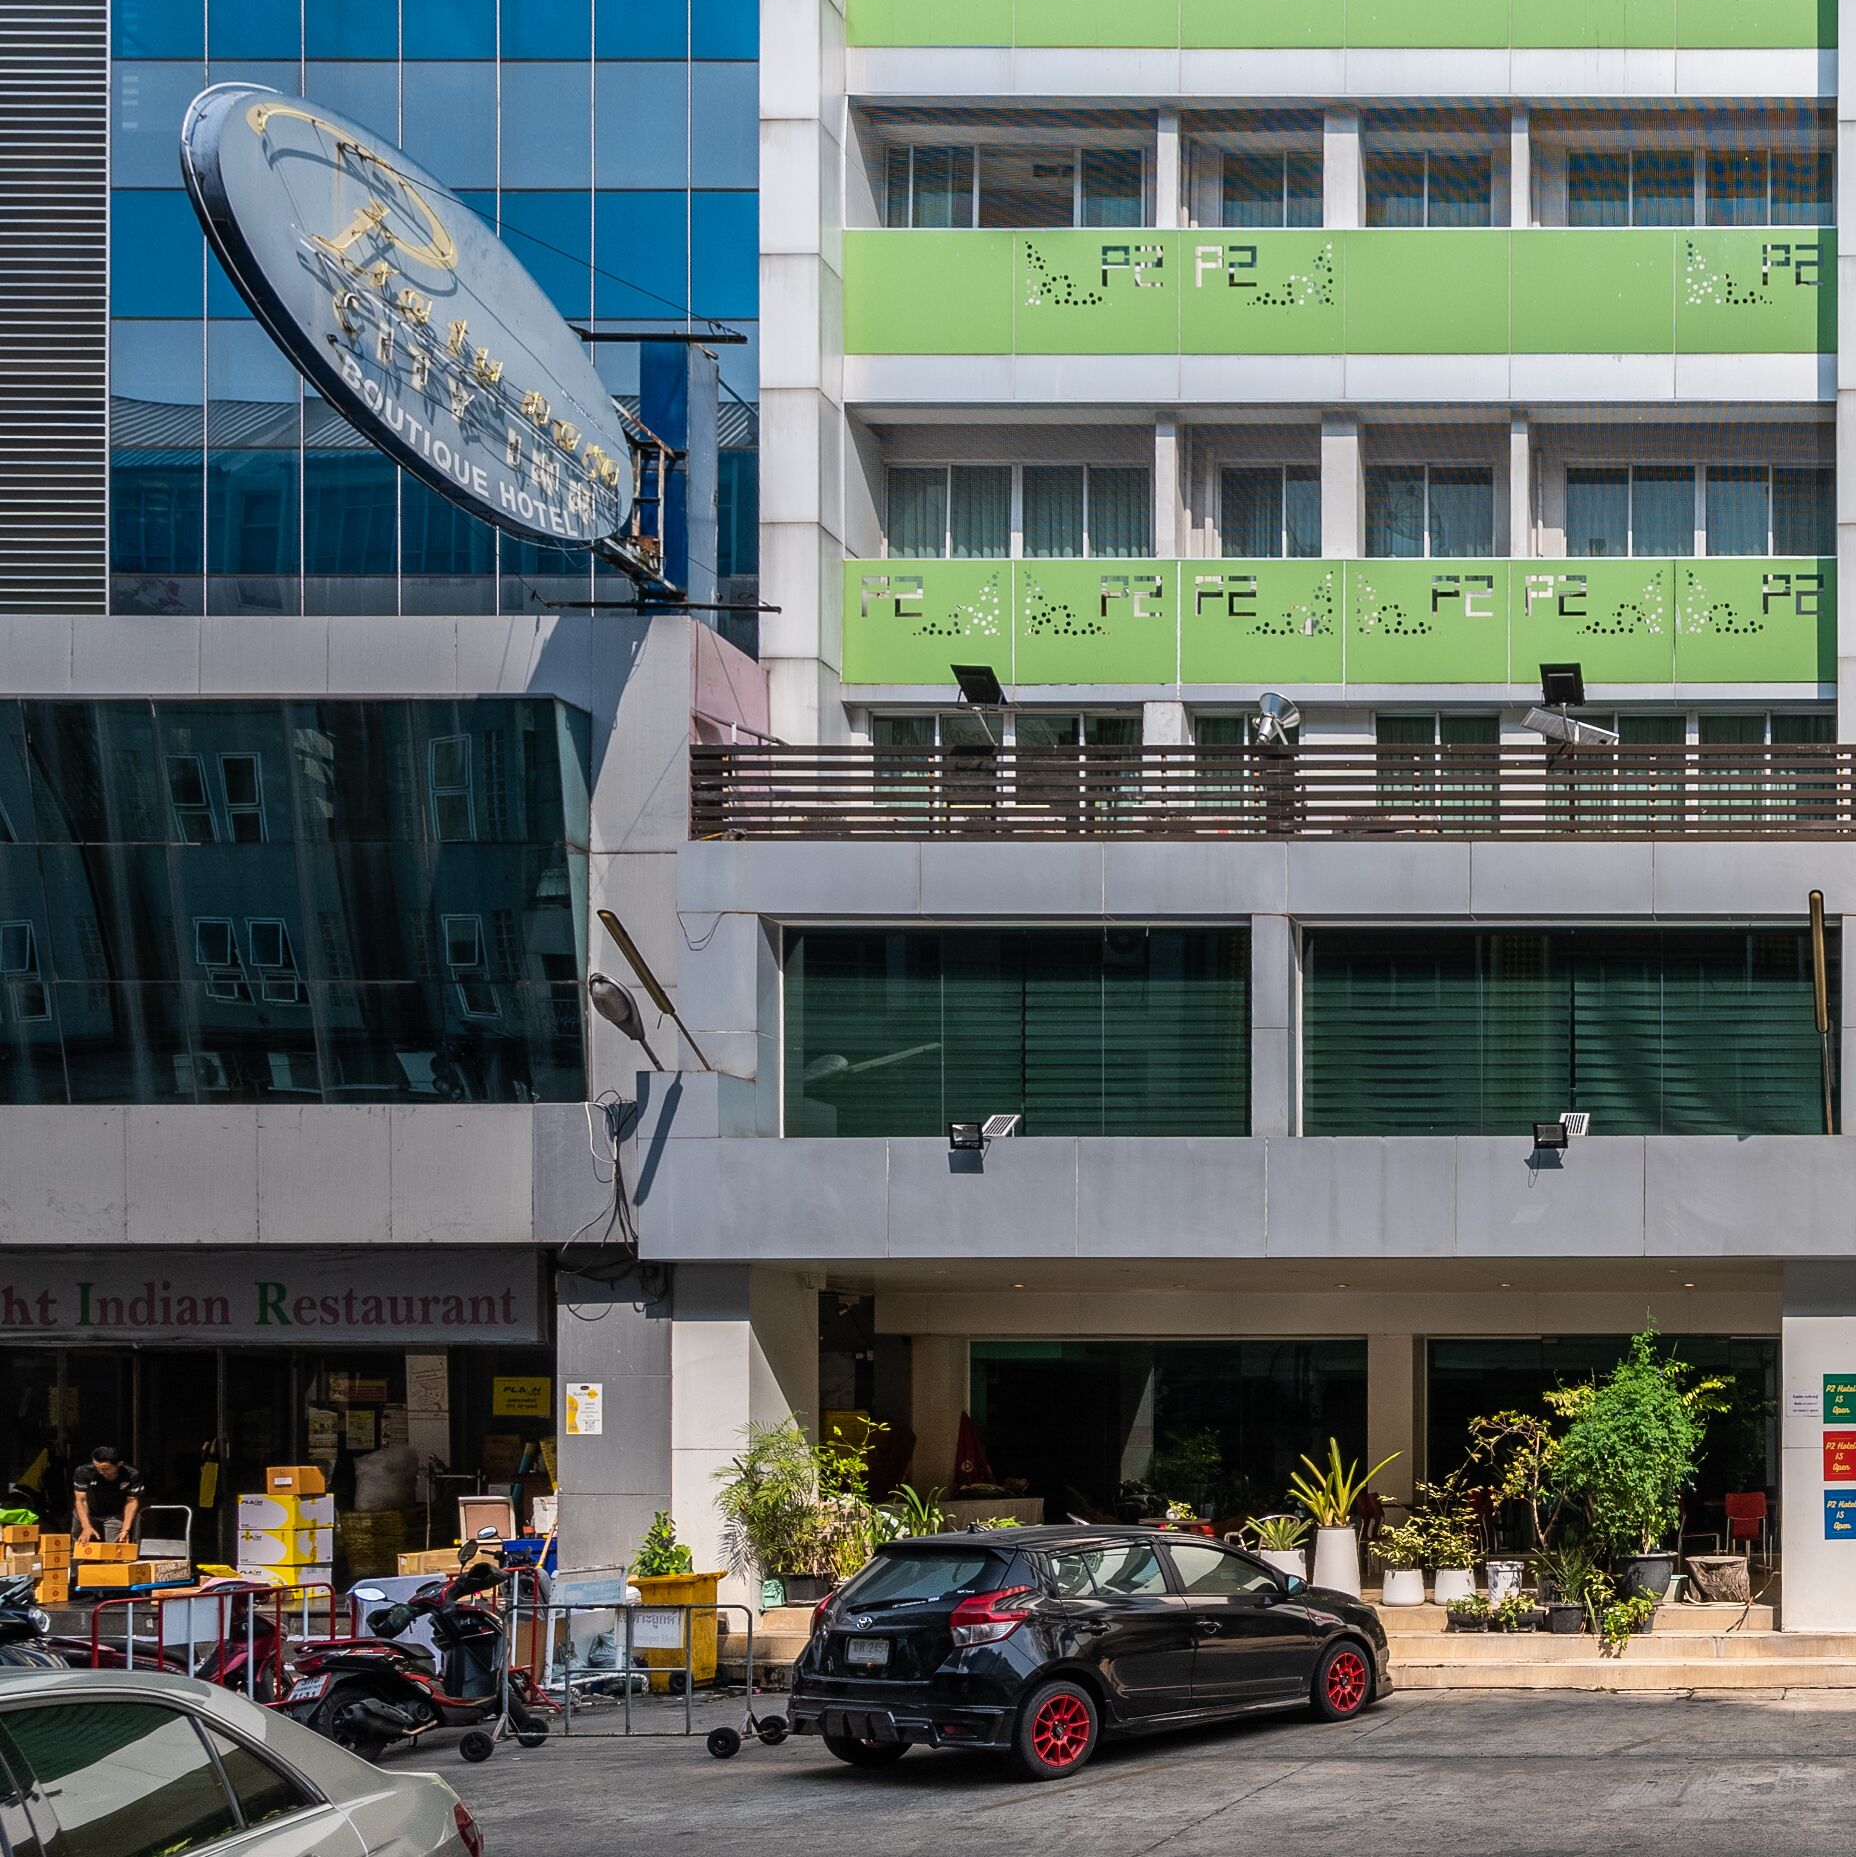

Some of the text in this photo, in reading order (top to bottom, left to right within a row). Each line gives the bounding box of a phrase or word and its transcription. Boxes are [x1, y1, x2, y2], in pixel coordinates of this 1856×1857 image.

[1101, 244, 1163, 287] P2
[1195, 244, 1257, 287] P2
[1763, 244, 1825, 287] P2
[342, 353, 580, 537] BOUTIQUE HOTEL
[860, 574, 922, 617] P2
[1101, 574, 1163, 617] P2
[1195, 574, 1257, 617] P2
[1431, 574, 1493, 617] P2
[1525, 574, 1587, 617] P2
[1762, 574, 1824, 617] P2
[76, 1280, 232, 1327] Indian
[254, 1281, 519, 1327] Restaurant
[1832, 1406, 1851, 1415] Open
[1832, 1463, 1851, 1472] Open
[1837, 1442, 1856, 1450] Hotel
[1833, 1522, 1852, 1530] Open
